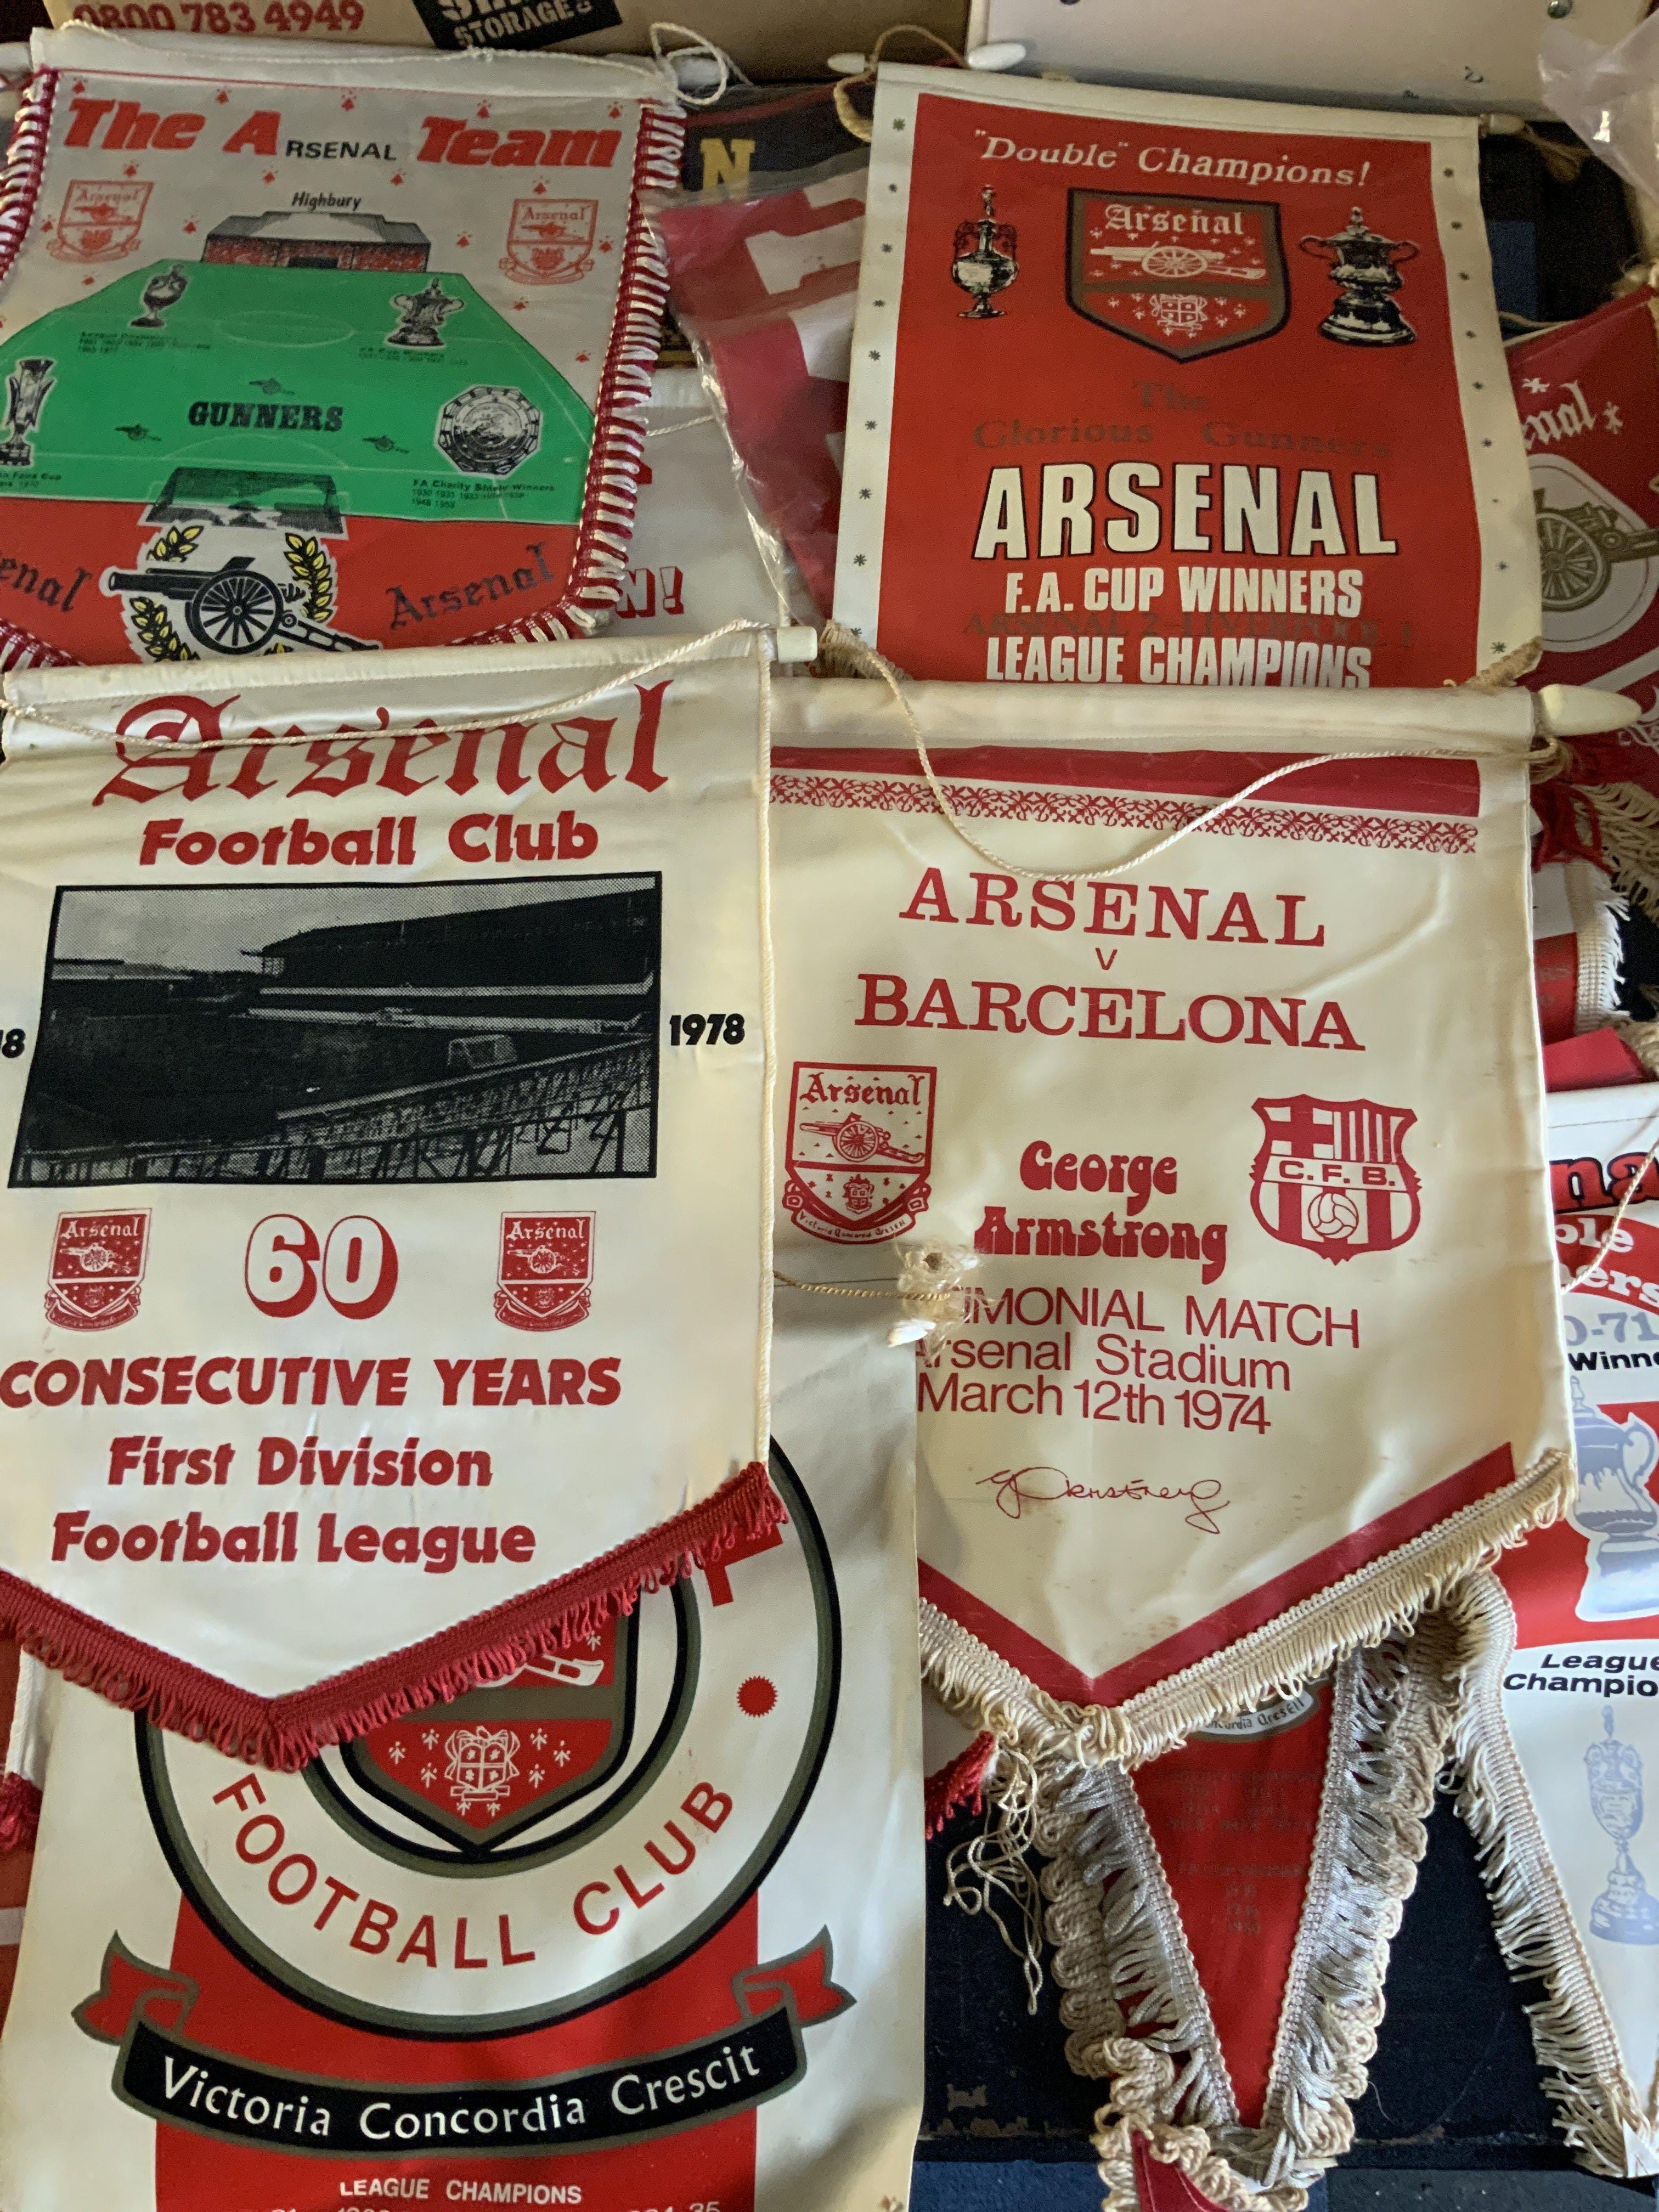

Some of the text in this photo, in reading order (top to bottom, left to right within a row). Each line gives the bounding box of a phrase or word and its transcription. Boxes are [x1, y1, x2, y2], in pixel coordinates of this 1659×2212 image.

[181, 2, 256, 33] 783
[264, 0, 364, 32] 4949
[453, 0, 575, 46] STORAGE
[63, 98, 206, 150] The
[417, 116, 622, 167] Team
[1138, 146, 1370, 187] Champions!
[291, 191, 362, 211] Highbury
[1104, 204, 1245, 236] Arsenal
[188, 401, 345, 432] GUNNERS
[971, 461, 1400, 561] ARSENAL
[385, 540, 558, 631] Arsenal
[1005, 566, 1364, 618] F.A. CUP WINNERS
[988, 635, 1372, 689] LEAGUE CHAMPIONS
[92, 679, 674, 806] Arsenal
[139, 810, 599, 866] Football Club
[899, 867, 1325, 949] ARSENAL
[669, 1013, 746, 1046] 1978
[854, 973, 1367, 1051] BARCELONA
[799, 1071, 926, 1106] Arsenal
[1019, 1139, 1178, 1216] George
[60, 1217, 141, 1239] Arsenal
[506, 1218, 586, 1241] Arsenal
[974, 1205, 1228, 1285] Armstrong
[245, 1212, 399, 1320] 60
[951, 1286, 1361, 1348] IMONIAL MATCH
[0, 1355, 622, 1409] CONSECUTIVE YEARS
[1096, 1333, 1291, 1392] Stadium
[917, 1372, 1272, 1435] March 12th 1974
[107, 1435, 493, 1487] First Division
[52, 1510, 537, 1574] Football League
[1503, 1672, 1659, 1699] Champio
[213, 1773, 733, 1970] FOOTBALL CLUB
[160, 2044, 761, 2140] Victoria Concordia Crescit
[340, 2178, 582, 2204] LEAGUE CHAMPIONS
